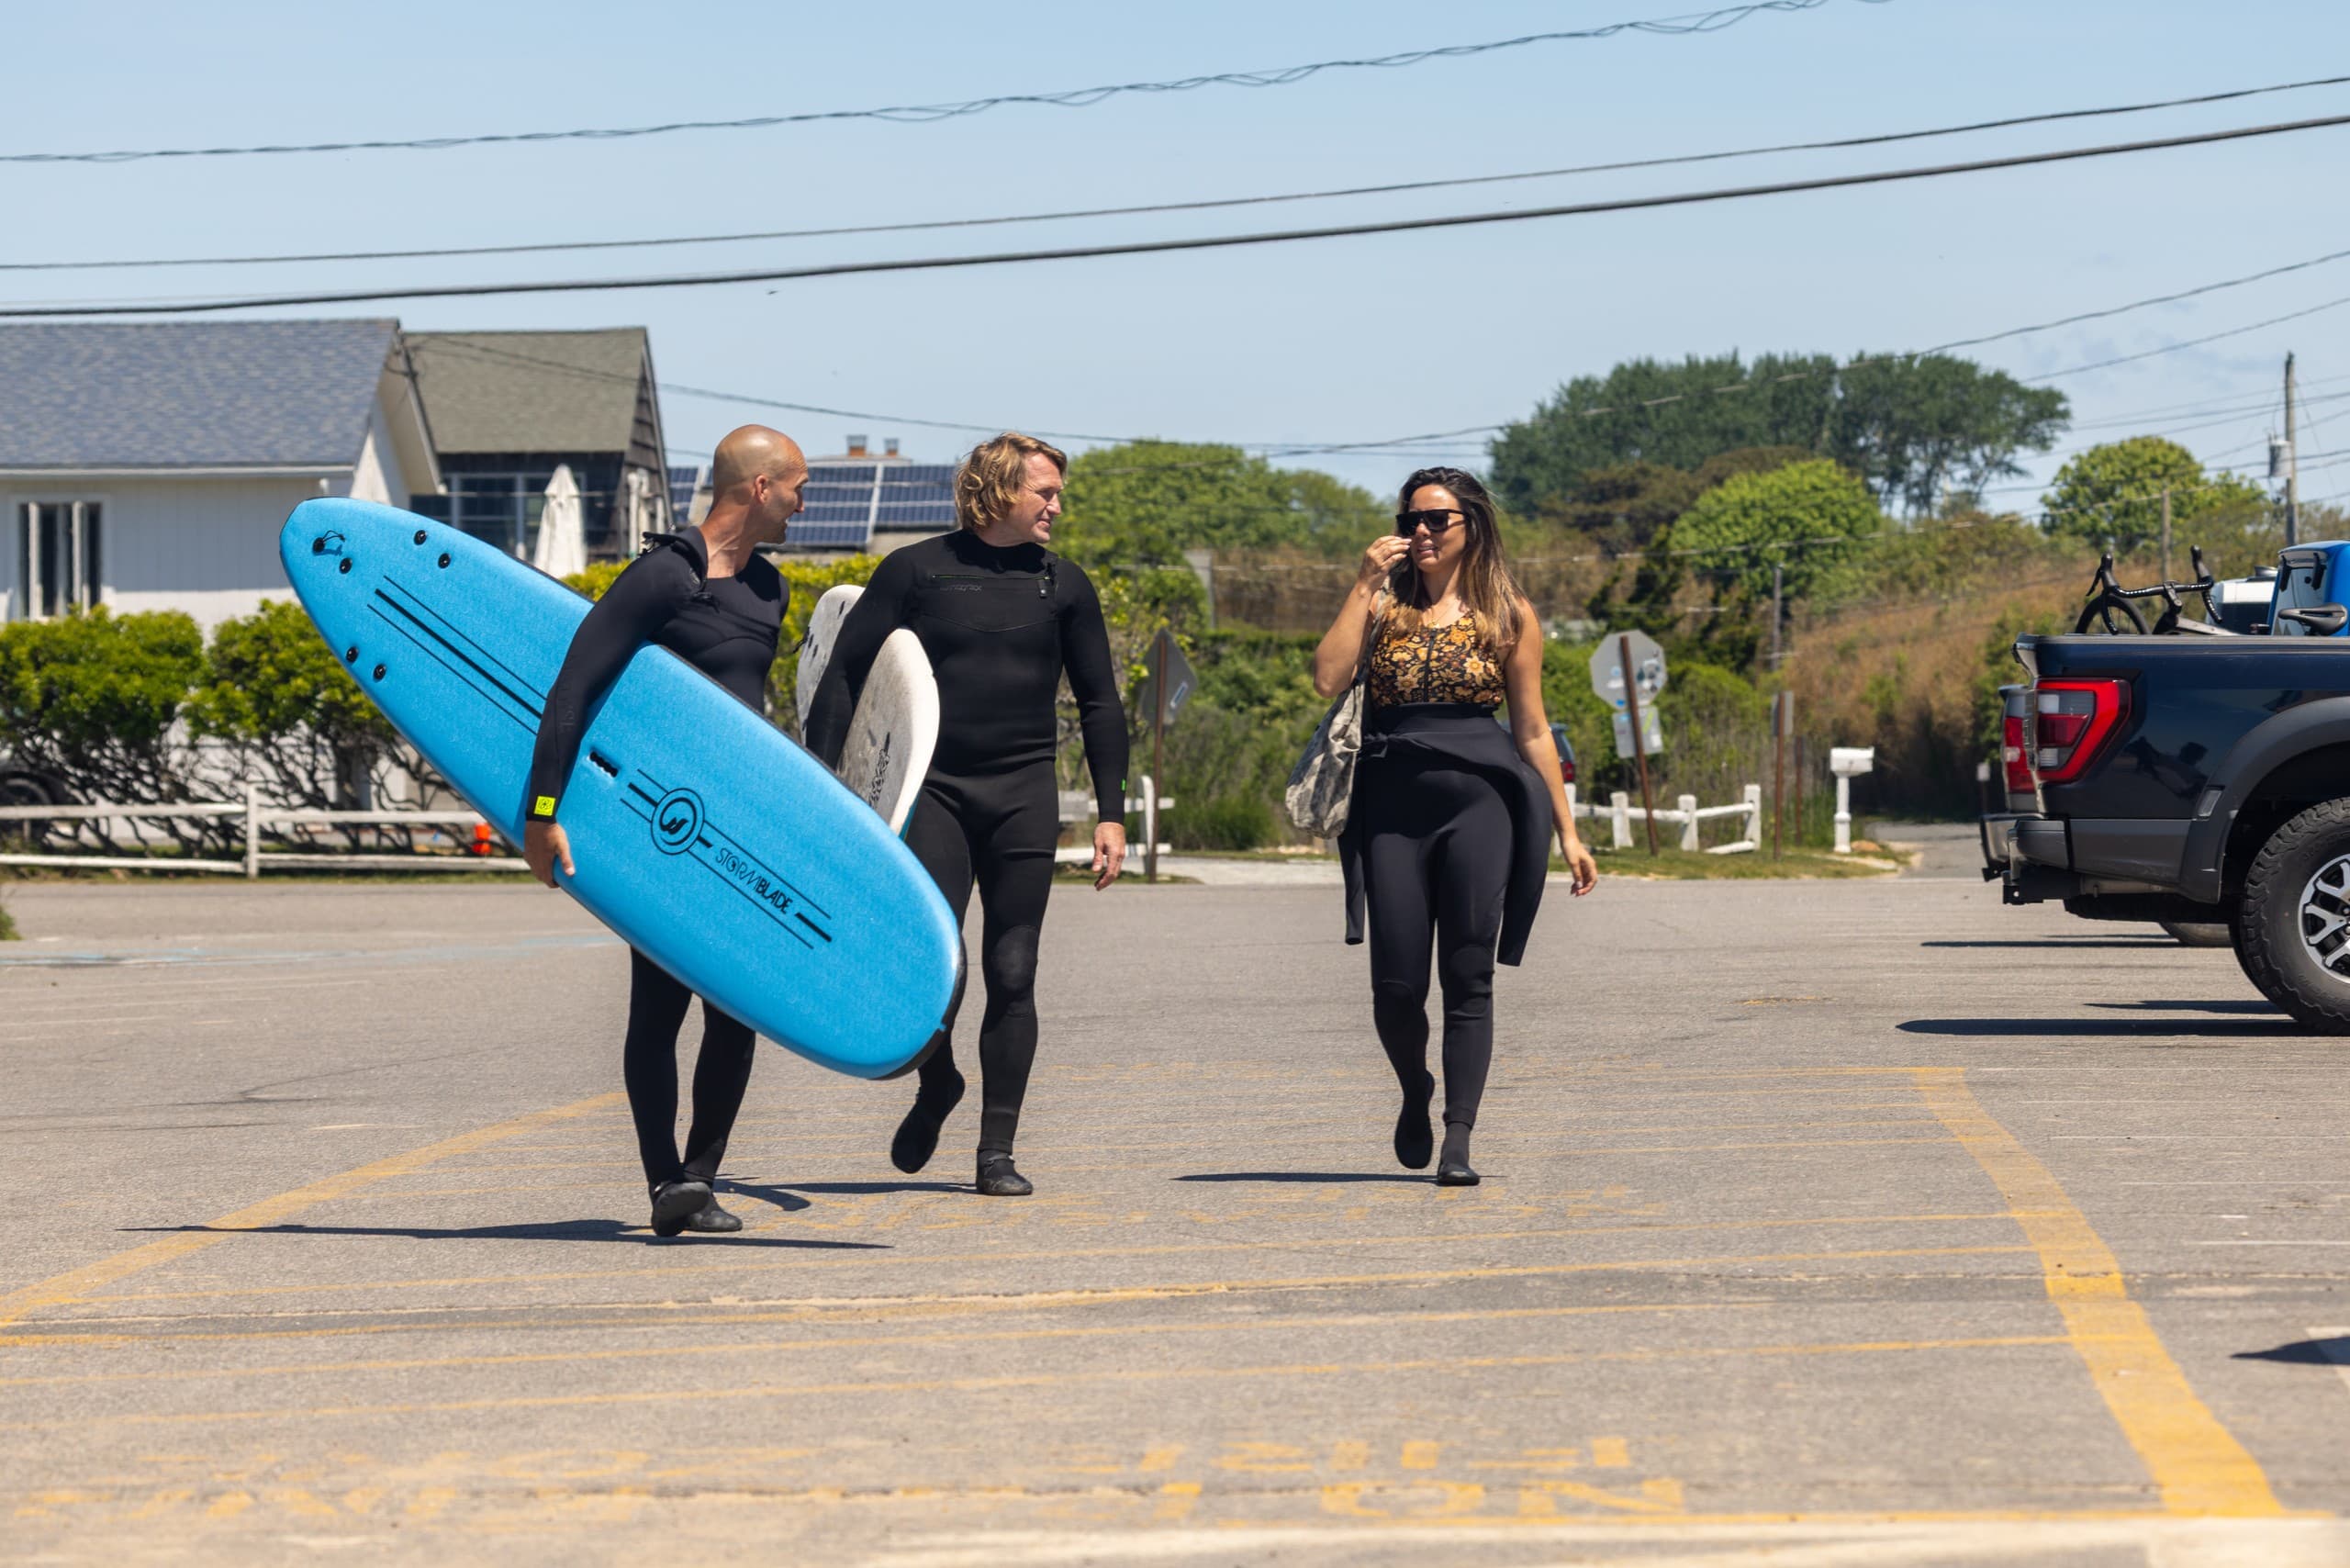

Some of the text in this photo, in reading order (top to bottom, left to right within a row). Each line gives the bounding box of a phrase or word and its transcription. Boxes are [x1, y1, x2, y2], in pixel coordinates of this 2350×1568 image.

[715, 848, 793, 914] STORMBLADE
[638, 1206, 1371, 1233] PARKIN
[1315, 1476, 1689, 1518] NO
